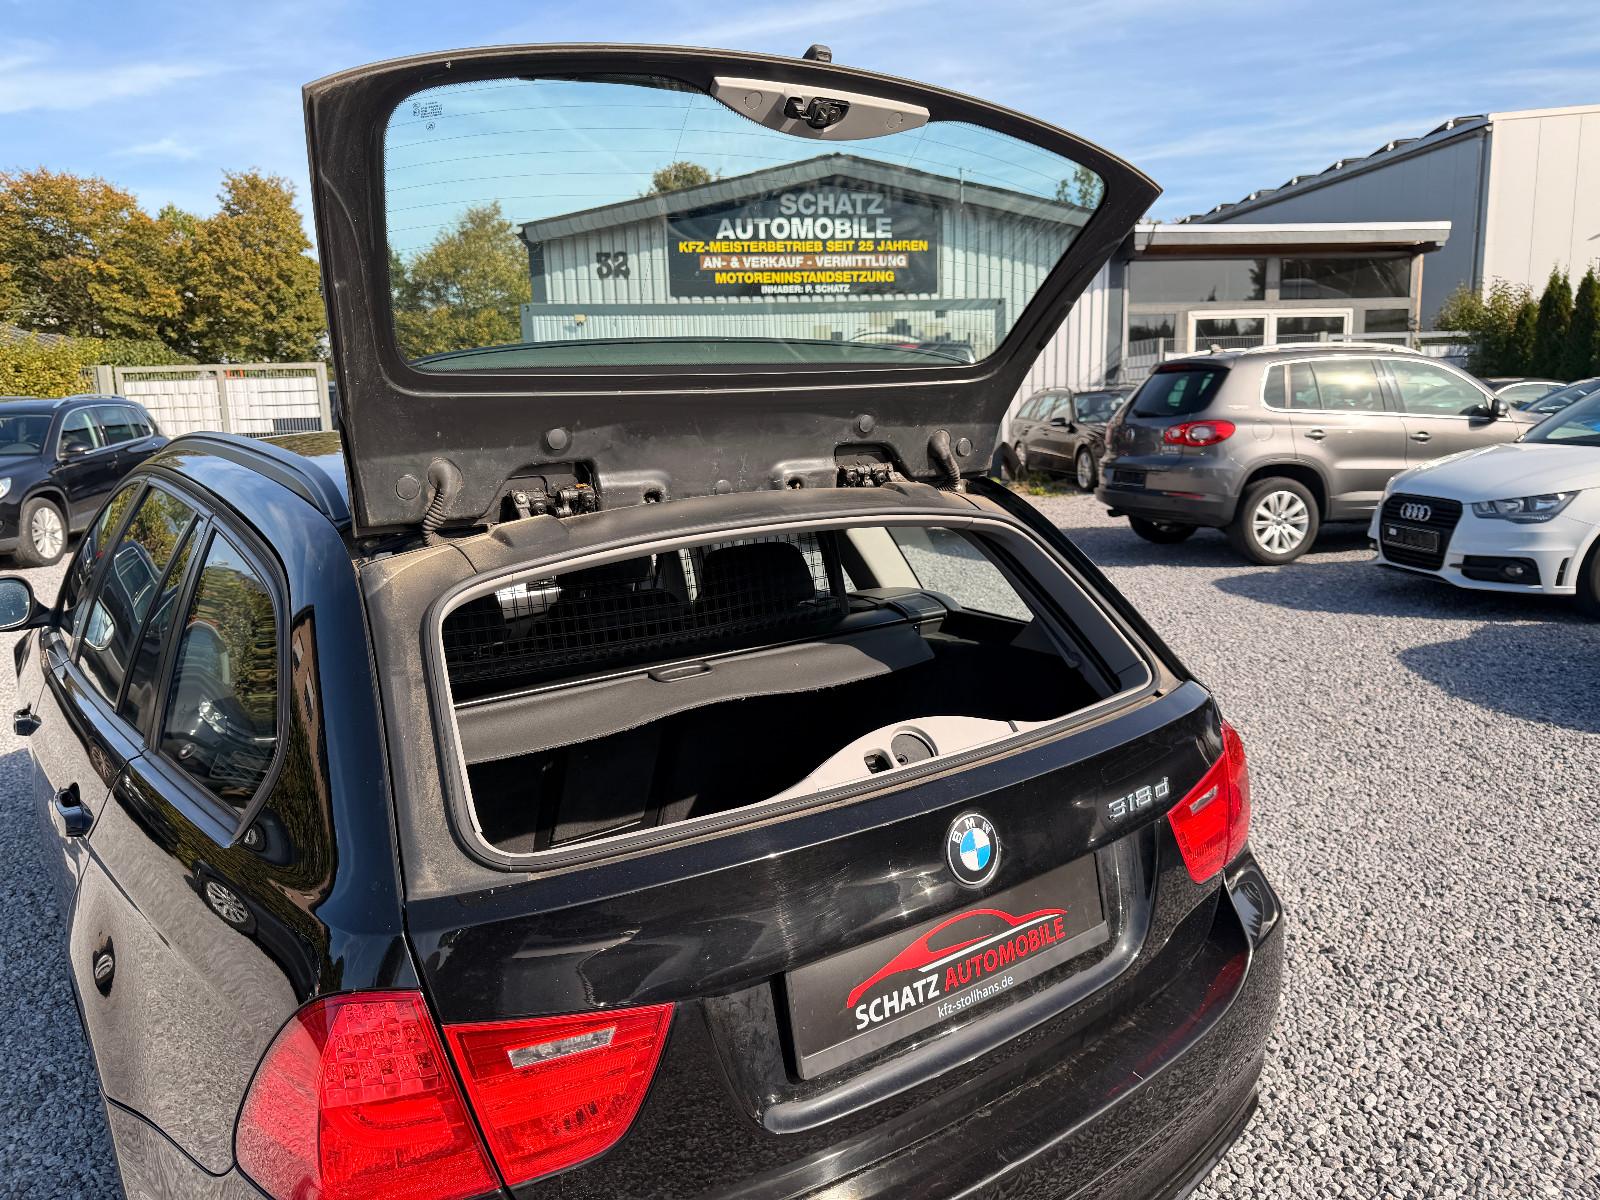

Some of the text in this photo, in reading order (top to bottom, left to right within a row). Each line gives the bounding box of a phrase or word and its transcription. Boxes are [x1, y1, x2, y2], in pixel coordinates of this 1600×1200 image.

[780, 193, 884, 216] SCHATZ
[715, 216, 893, 240] AUTOMOBILE
[678, 240, 928, 253] KFZ-MEISTERBETRIEB SEIT 25 JAHREN
[703, 257, 727, 269] AN-
[730, 257, 739, 268] &
[742, 256, 804, 268] VERKAUF
[815, 255, 907, 267] VERMITTLUNG
[715, 271, 895, 284] MOTORENINSTANDSETZUNG
[761, 284, 850, 294] INHABER: P. SCHATZ
[1108, 777, 1169, 819] 318d
[952, 817, 991, 843] BMW
[855, 917, 1066, 1030] SCHATZ AUTOMOBILE
[938, 975, 1014, 1018] kfz-stollhans.de
